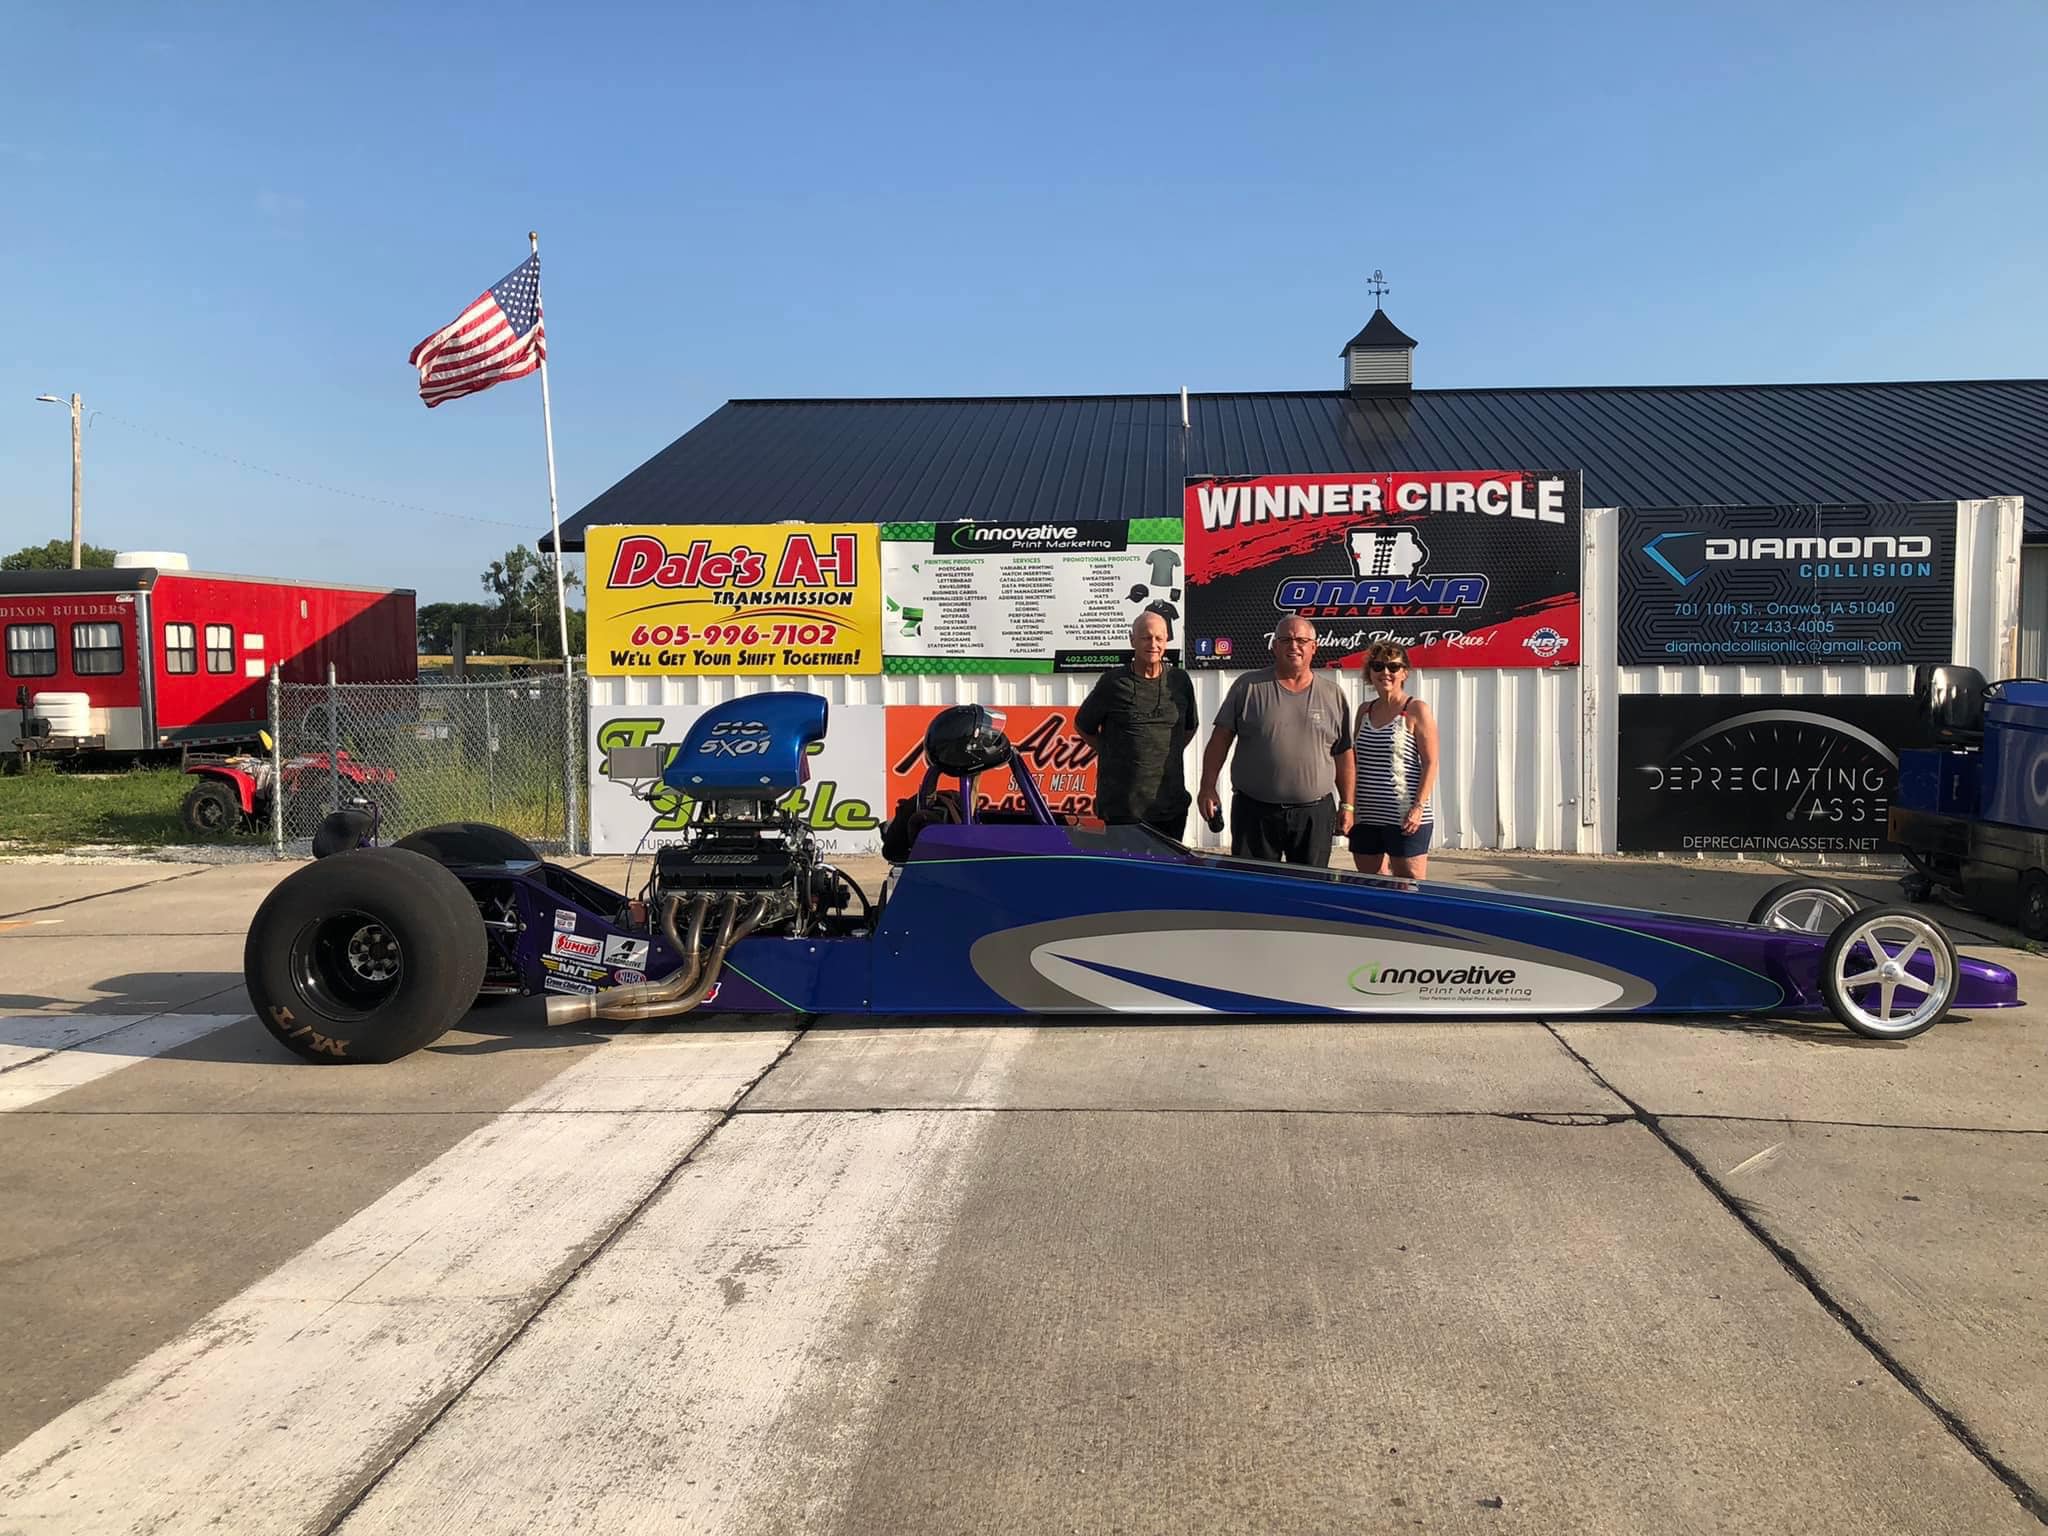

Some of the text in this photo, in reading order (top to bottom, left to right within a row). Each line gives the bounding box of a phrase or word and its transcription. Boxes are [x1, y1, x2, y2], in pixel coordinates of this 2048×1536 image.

[1197, 480, 1565, 530] WINNER CIRCLE
[1012, 539, 1111, 549] Print Marketing
[1705, 536, 1931, 561] DIAMOND
[606, 533, 857, 589] Dale's A-1
[1799, 563, 1931, 578] COLLISION
[712, 591, 853, 605] TRANSMISSION
[1279, 578, 1486, 606] ONAWA
[0, 605, 127, 616] DIXON BUILDERS
[1300, 605, 1456, 617] DRAGWAY
[1674, 603, 1698, 616] 701
[1706, 603, 1736, 615] 10th
[1766, 602, 1825, 615] Onawa,
[1830, 602, 1844, 614] IA
[1848, 601, 1895, 614] 51040
[1732, 620, 1834, 633] 712-433-4005
[631, 624, 837, 646] 605-996-7102
[1417, 630, 1437, 648] To
[1442, 629, 1498, 649] Race!
[1664, 639, 1902, 654] diamondcollisionllc@gmail.com
[699, 737, 771, 757] 5X01
[1050, 773, 1086, 792] METAL
[1649, 767, 1884, 792] DEPRECIATING
[1683, 836, 1879, 849] DEPRECIATINGASSETS.NET
[1419, 987, 1532, 996] Print Marketing
